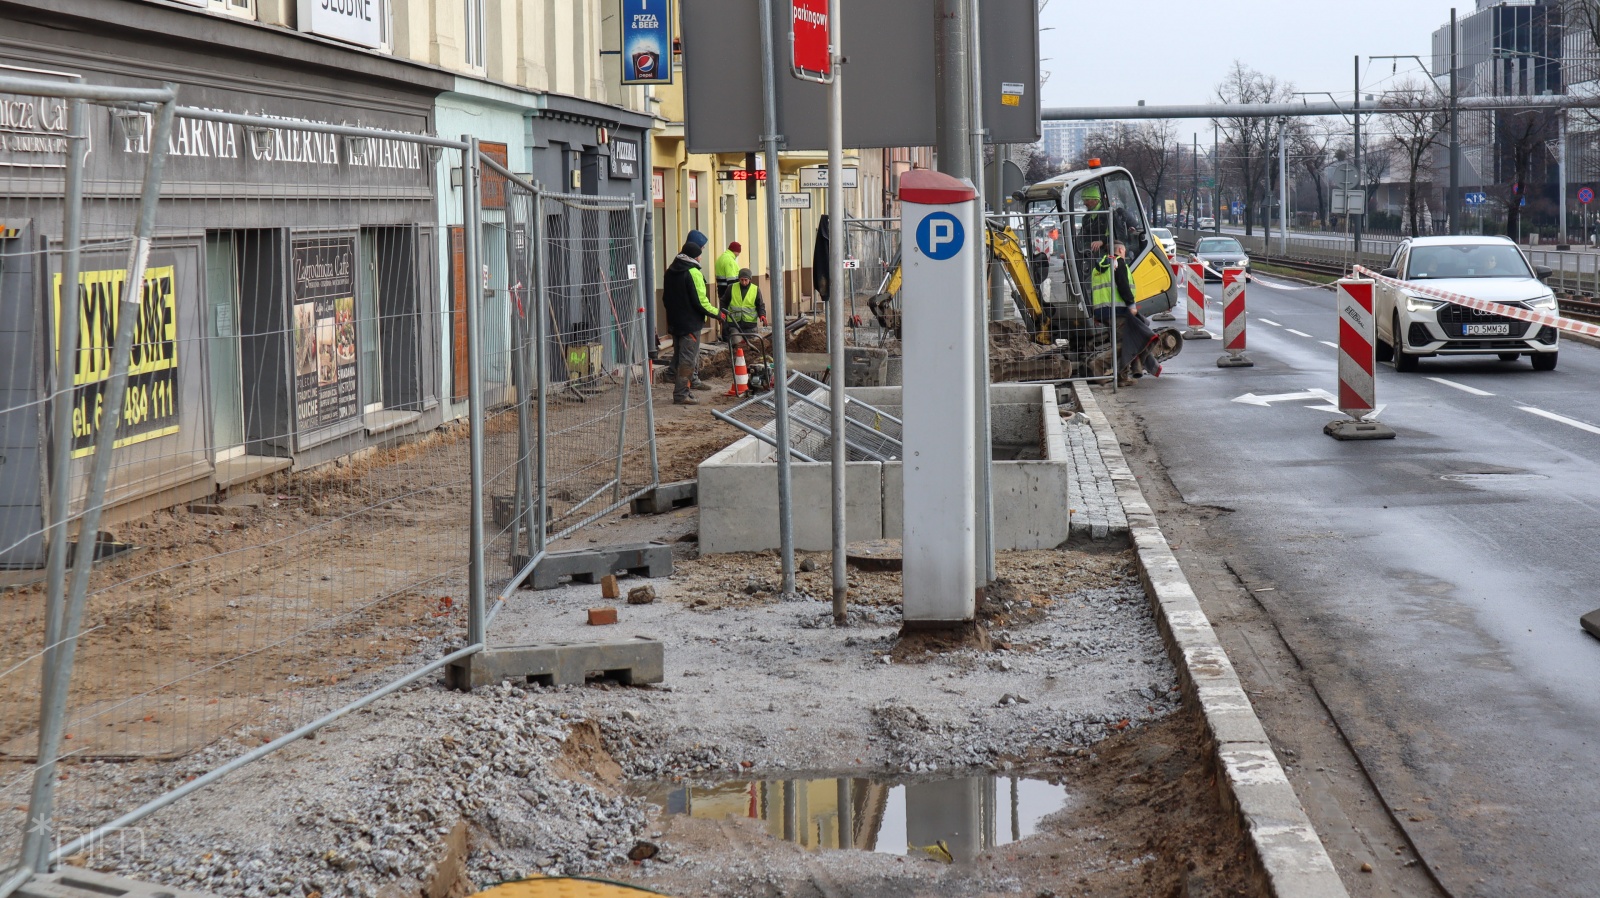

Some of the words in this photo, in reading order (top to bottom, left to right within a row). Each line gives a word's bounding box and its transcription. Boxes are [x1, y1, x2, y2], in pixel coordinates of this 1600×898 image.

[633, 14, 657, 22] PIZZA
[793, 3, 828, 32] parkingowy
[631, 21, 638, 29] &
[638, 21, 659, 29] BEER
[733, 171, 767, 180] 29-12
[929, 218, 954, 253] P
[1482, 325, 1508, 334] 5MM36
[72, 396, 91, 438] el.
[124, 384, 148, 426] 484
[151, 378, 174, 419] 111
